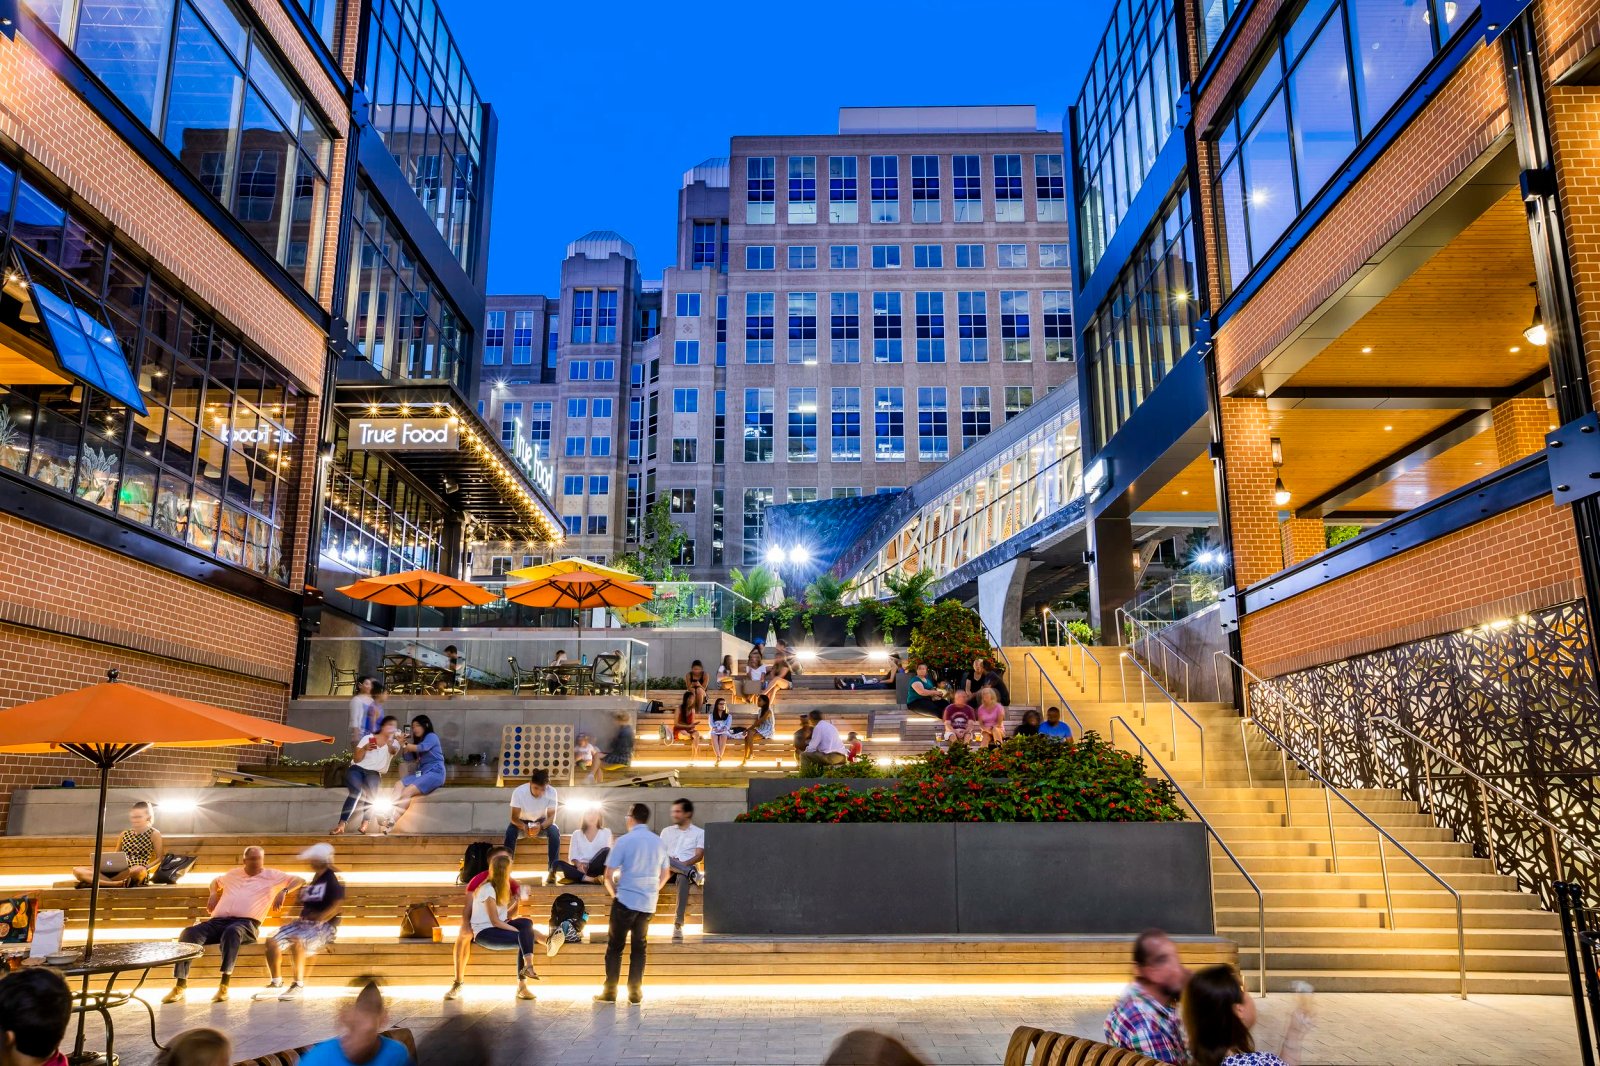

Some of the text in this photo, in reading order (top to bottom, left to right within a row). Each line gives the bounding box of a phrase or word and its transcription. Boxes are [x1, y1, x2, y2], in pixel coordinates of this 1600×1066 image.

[359, 423, 448, 444] True Food
[513, 417, 553, 496] True Food
